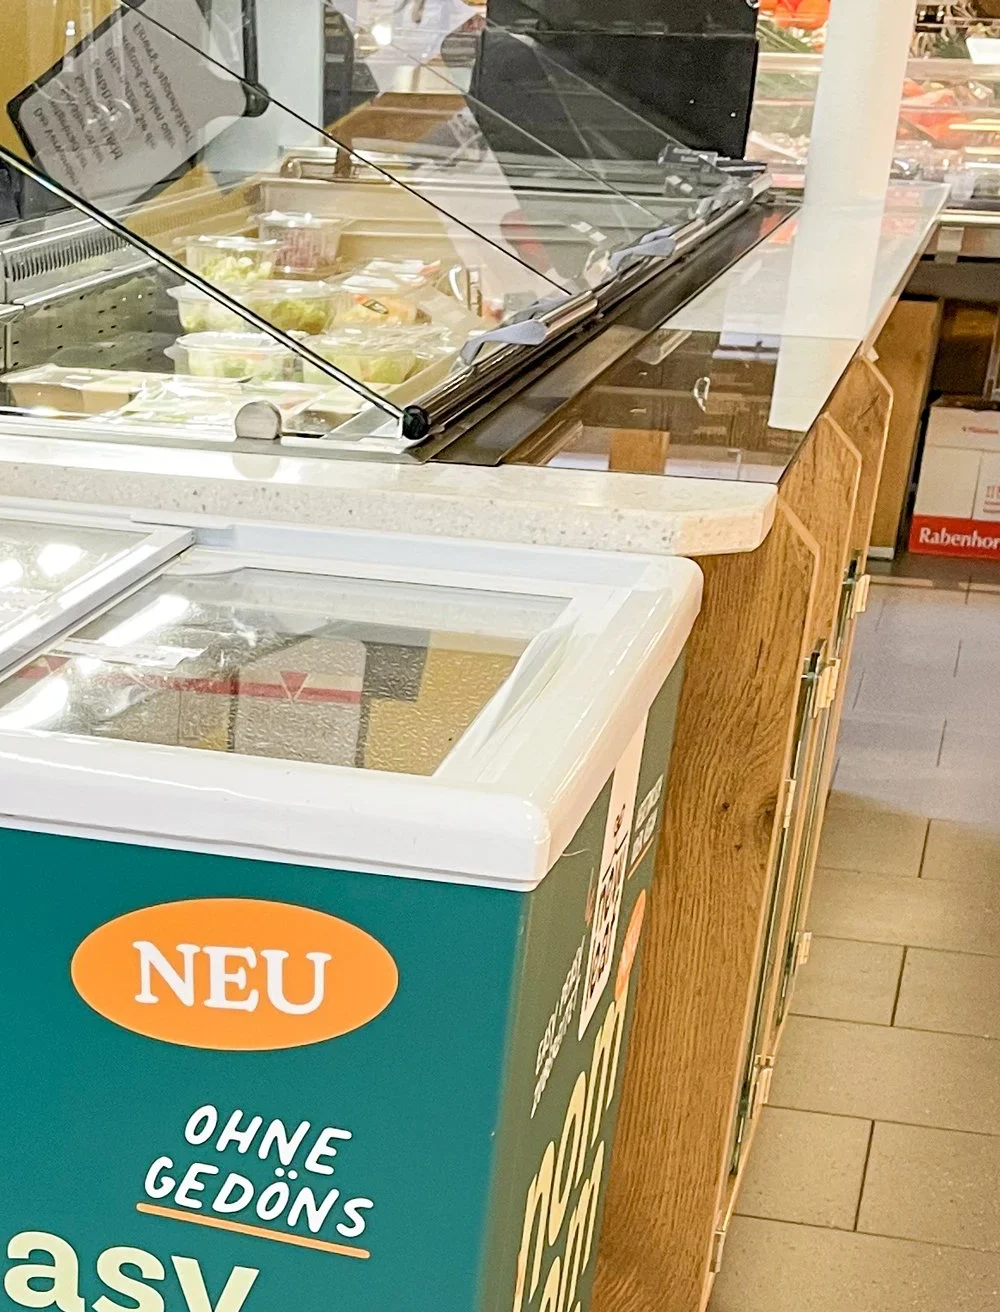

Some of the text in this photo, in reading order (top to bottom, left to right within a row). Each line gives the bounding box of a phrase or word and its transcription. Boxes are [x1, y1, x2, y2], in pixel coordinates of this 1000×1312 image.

[132, 940, 333, 1016] NEU
[184, 1104, 352, 1175] OHNE
[143, 1156, 374, 1239] GEDÖNS
